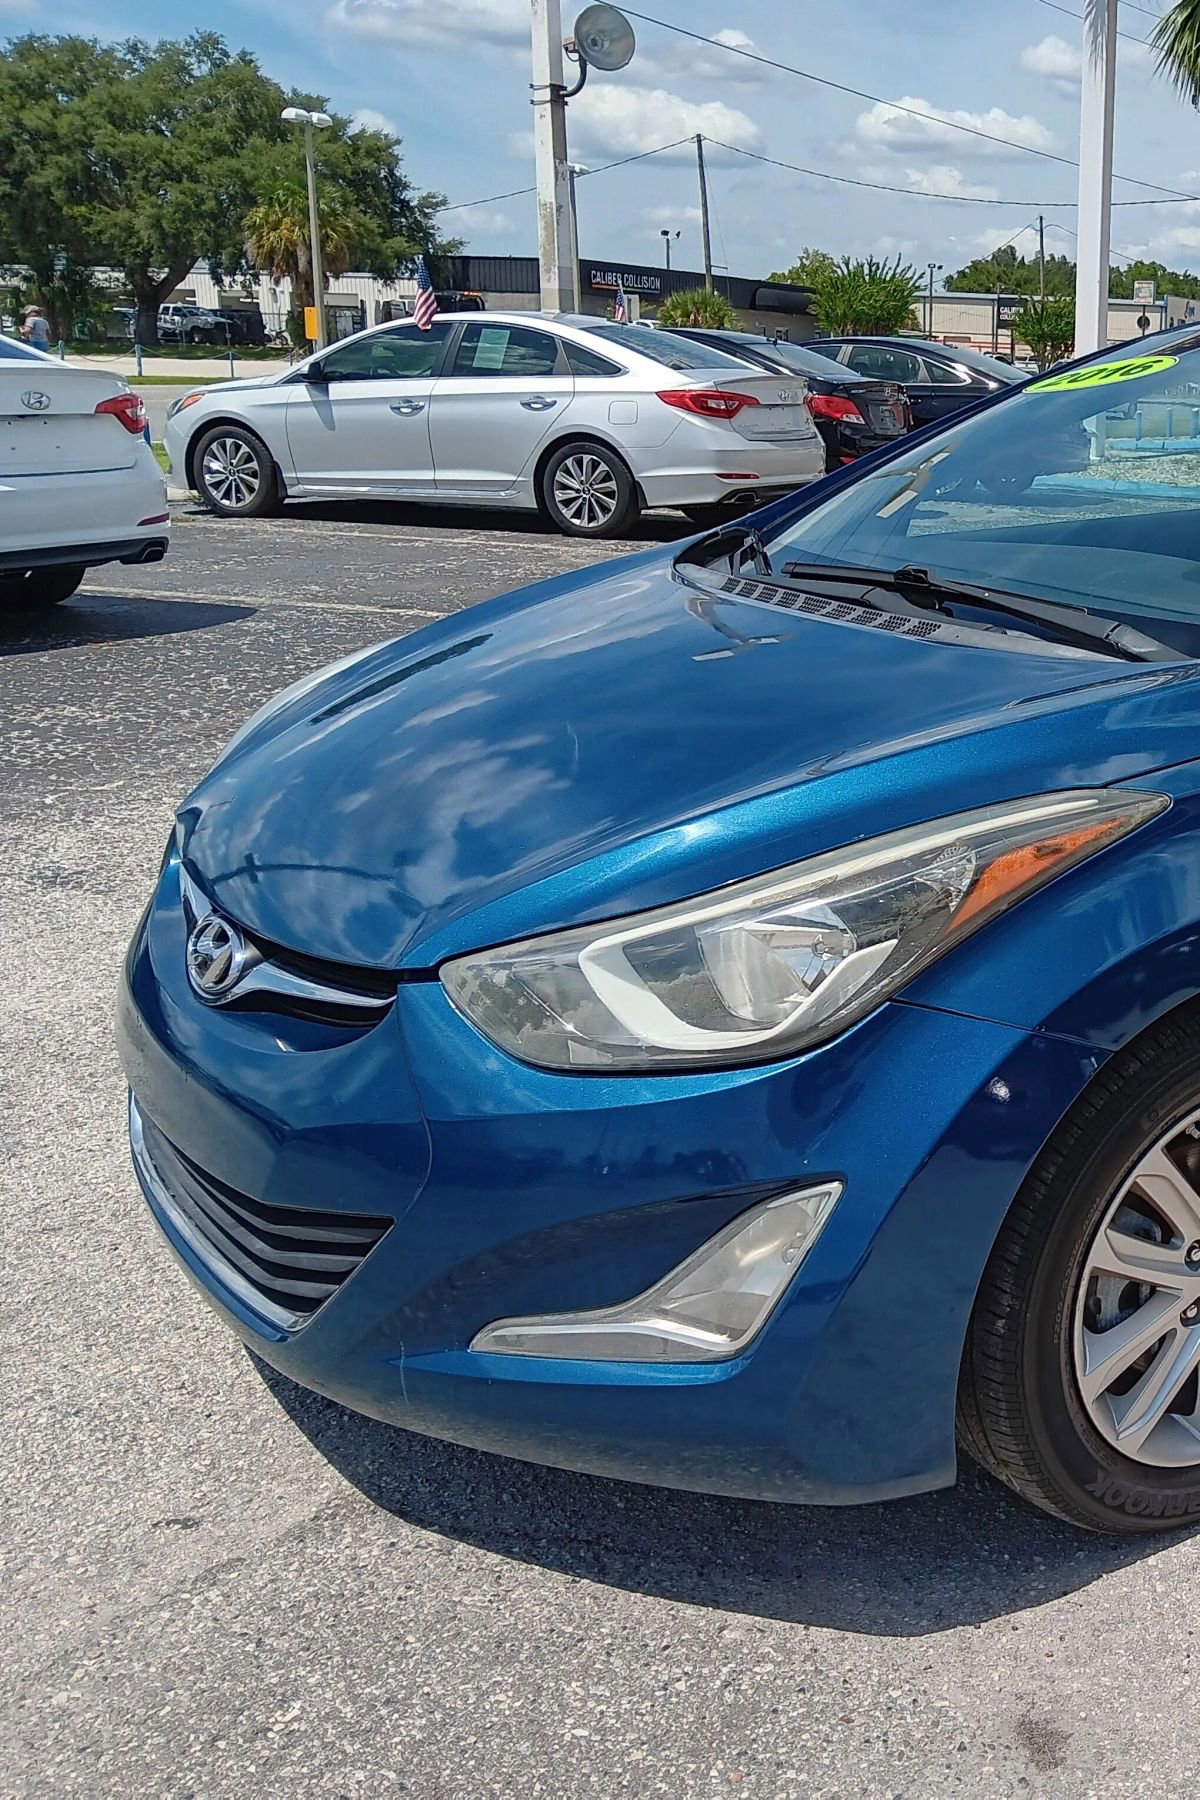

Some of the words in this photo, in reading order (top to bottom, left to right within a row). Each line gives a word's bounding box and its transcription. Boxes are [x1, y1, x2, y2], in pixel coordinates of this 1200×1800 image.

[591, 270, 622, 286] CALIBER
[623, 273, 661, 290] COLLISION
[1034, 359, 1164, 389] 2016
